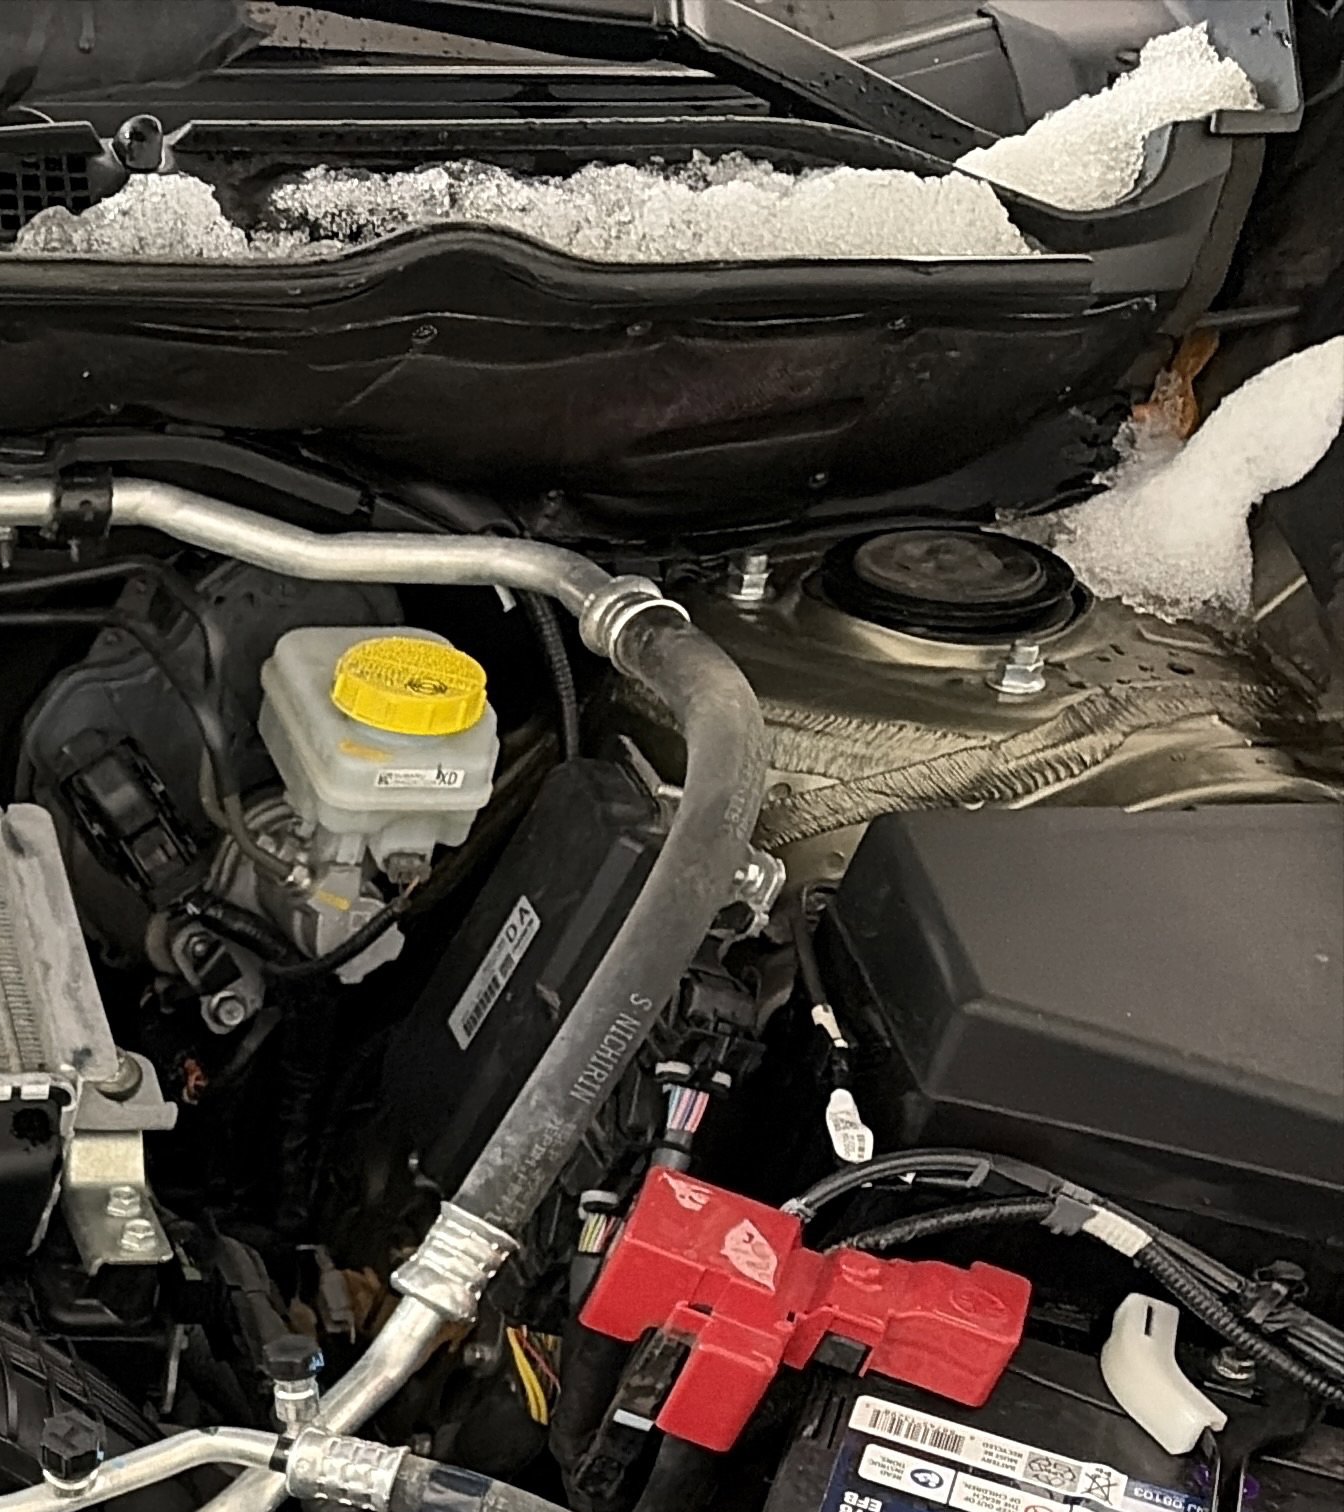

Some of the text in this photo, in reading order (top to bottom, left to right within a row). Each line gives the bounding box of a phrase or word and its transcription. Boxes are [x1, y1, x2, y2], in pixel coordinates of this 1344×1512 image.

[568, 1010, 641, 1106] NICHIRIN
[841, 1489, 883, 1512] EFB
[1132, 1486, 1183, 1509] 08103
